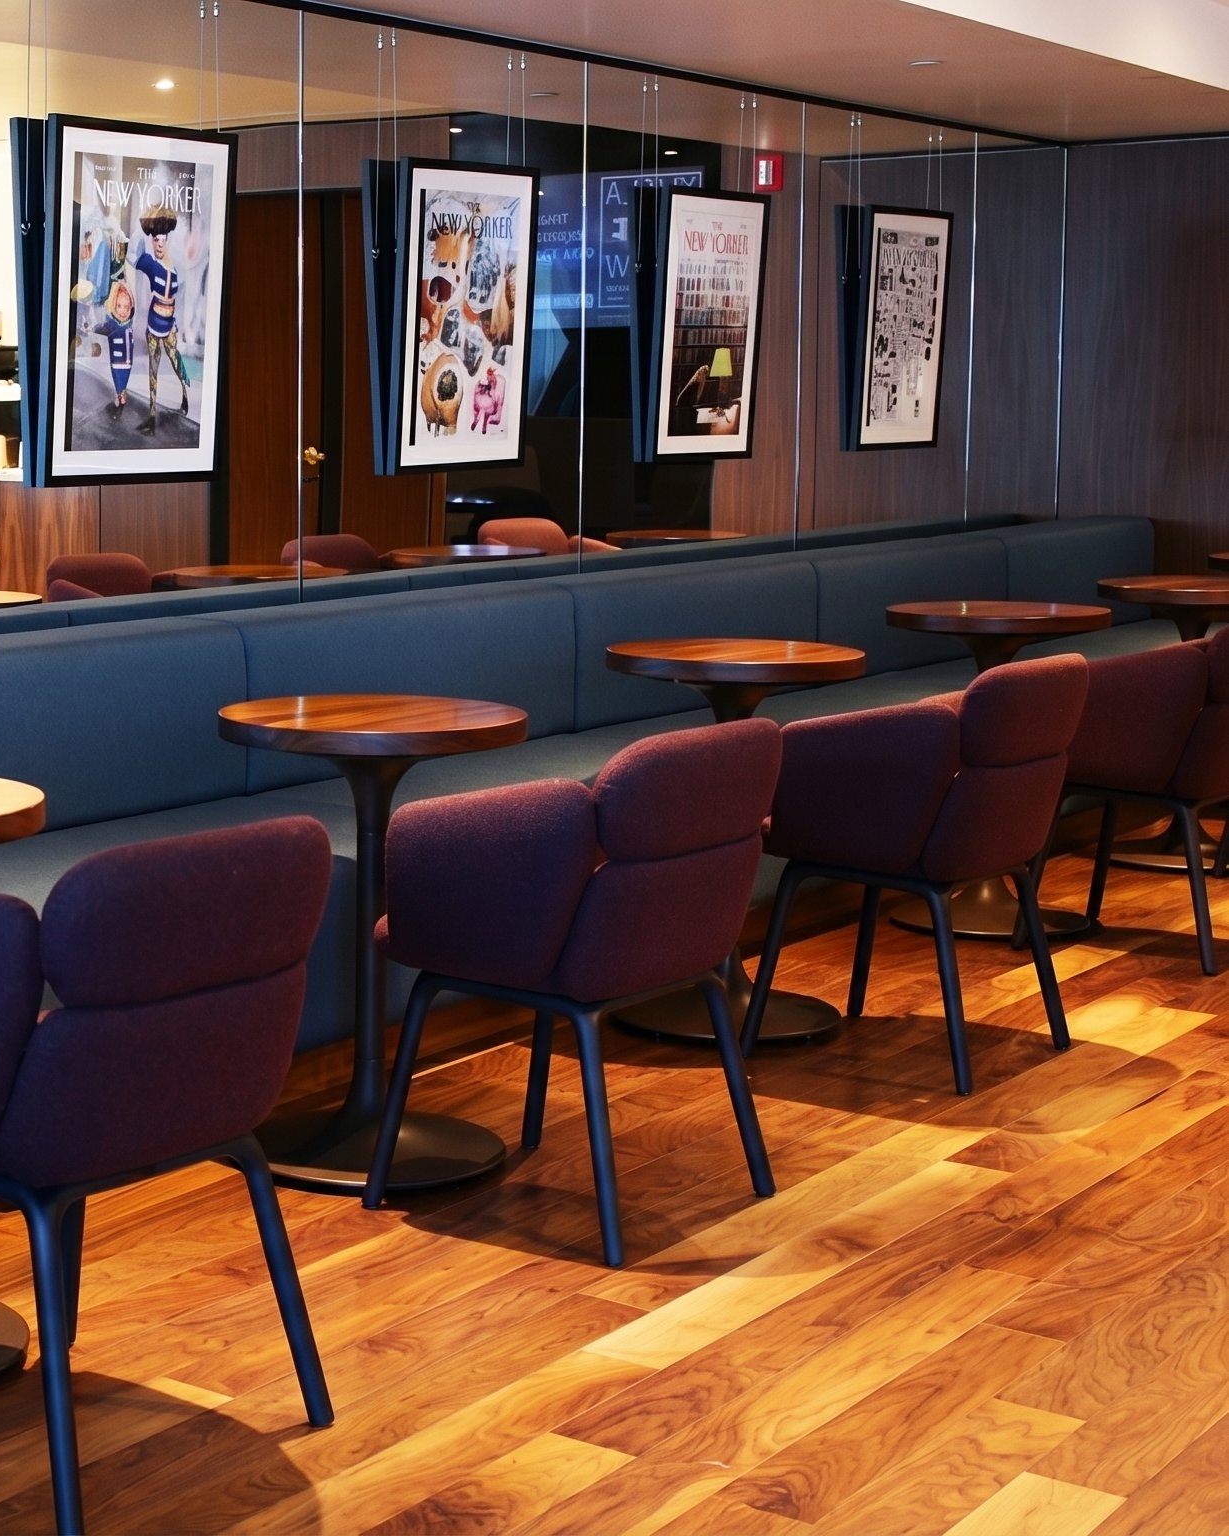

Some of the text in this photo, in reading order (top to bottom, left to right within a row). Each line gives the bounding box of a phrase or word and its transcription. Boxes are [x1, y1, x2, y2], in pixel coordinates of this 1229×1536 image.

[93, 179, 202, 215] NEW YORKER
[431, 212, 462, 236] NEW
[684, 230, 710, 252] NEW
